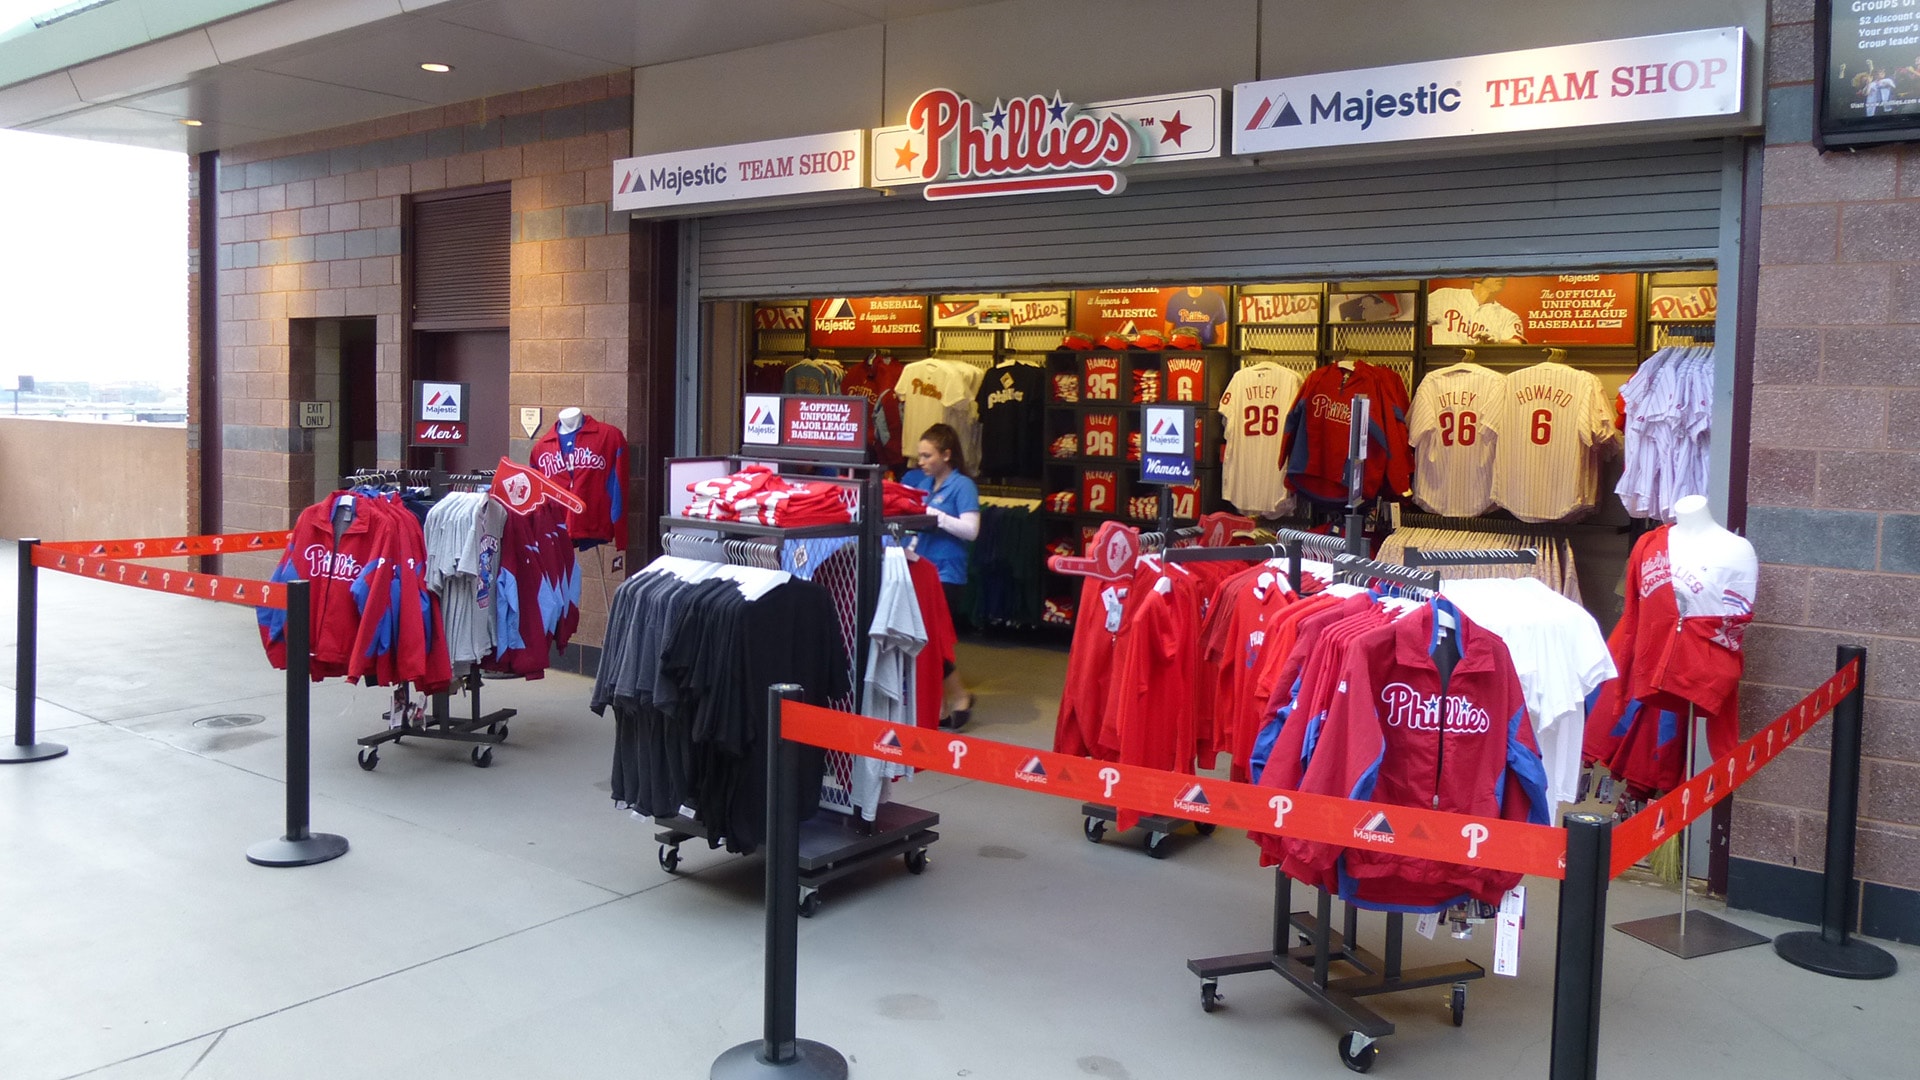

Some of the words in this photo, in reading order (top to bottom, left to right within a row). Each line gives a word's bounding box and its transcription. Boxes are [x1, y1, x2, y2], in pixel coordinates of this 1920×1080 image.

[1852, 0, 1898, 12] Groups
[1874, 12, 1913, 23] discount
[1859, 28, 1881, 37] Your
[1884, 23, 1919, 35] group's
[1859, 40, 1886, 49] Group
[1889, 36, 1919, 46] leader
[1310, 82, 1461, 131] Majestic
[1486, 70, 1599, 108] TEAM
[1611, 57, 1728, 97] SHOP
[907, 88, 1131, 180] Phillies
[650, 162, 727, 195] Majestic
[739, 156, 794, 181] TEAM
[799, 150, 855, 175] SHOP
[1555, 289, 1616, 299] OFFICIAL
[1241, 295, 1319, 322] Phillies
[1542, 299, 1601, 309] UNIFORM
[1603, 298, 1615, 309] of
[1011, 302, 1058, 326] hillies
[1528, 310, 1572, 319] MAJOR
[1574, 309, 1628, 318] LEAGUE
[815, 320, 855, 334] Majestic
[1528, 320, 1594, 329] BASEBALL
[1167, 358, 1202, 373] HOWARD
[1087, 373, 1117, 399] 35
[1177, 376, 1193, 401] 6
[1245, 385, 1278, 401] UTLEY
[1438, 391, 1477, 408] UTLEY
[1516, 386, 1573, 408] HOWARD
[307, 403, 323, 413] EXIT
[426, 406, 457, 415] Majestic
[809, 403, 850, 412] OFFICIAL
[306, 416, 324, 426] ONLY
[800, 412, 840, 421] UNIFORM
[1244, 405, 1279, 437] 26
[420, 424, 461, 439] Men's
[748, 425, 775, 435] Majestic
[791, 421, 822, 430] MAJOR
[822, 422, 858, 432] LEAGUE
[1439, 411, 1477, 446] 26
[1530, 409, 1552, 446] 6
[791, 430, 835, 440] BASEBALL
[1150, 436, 1180, 446] Majestic
[1086, 431, 1114, 456] 26
[1146, 458, 1190, 476] Women's
[1089, 484, 1106, 512] 2
[1381, 682, 1490, 733] Phillies
[873, 743, 903, 756] Majestic
[948, 740, 968, 769] P
[1014, 770, 1047, 785] Majestic
[1098, 767, 1120, 798] P
[1173, 799, 1210, 815] Majestic
[1268, 795, 1293, 828] P
[1353, 828, 1395, 845] Majestic
[1461, 823, 1489, 859] P
